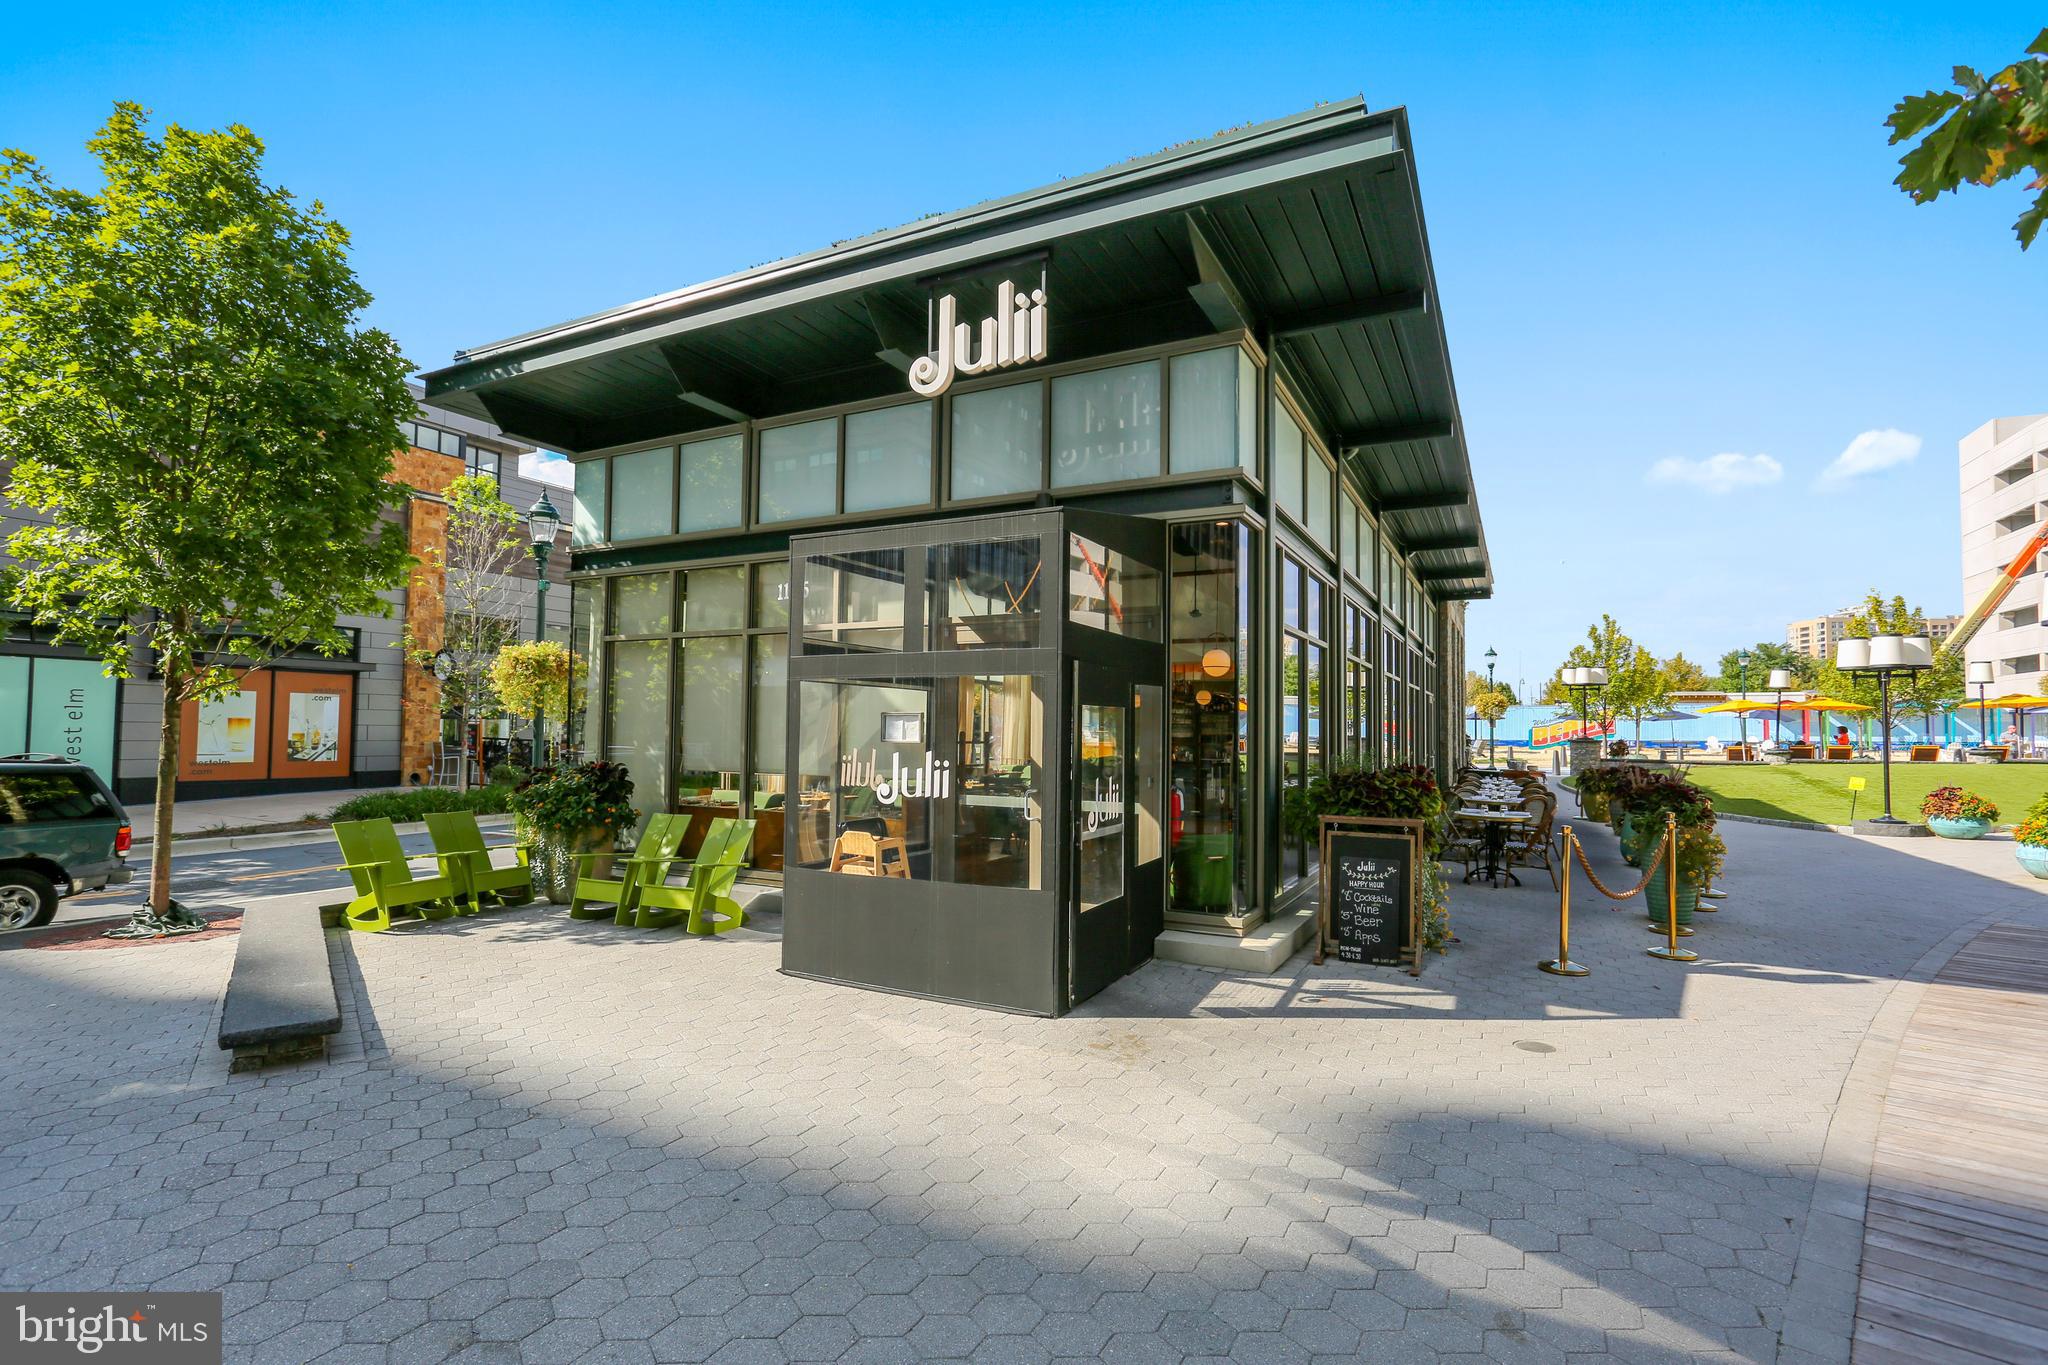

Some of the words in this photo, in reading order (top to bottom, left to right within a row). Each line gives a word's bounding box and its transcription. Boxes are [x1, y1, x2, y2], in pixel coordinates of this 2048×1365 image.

[909, 279, 1047, 397] Julii
[64, 688, 84, 720] elm
[876, 750, 950, 804] Julii
[1087, 776, 1119, 832] Julii
[1357, 861, 1376, 871] Julii
[1349, 880, 1368, 888] HAPPY
[1369, 881, 1385, 889] HOUR
[1353, 892, 1393, 904] Cocktails
[1354, 903, 1380, 914] Wine
[1354, 914, 1383, 927] Beer
[1354, 929, 1381, 945] Apps
